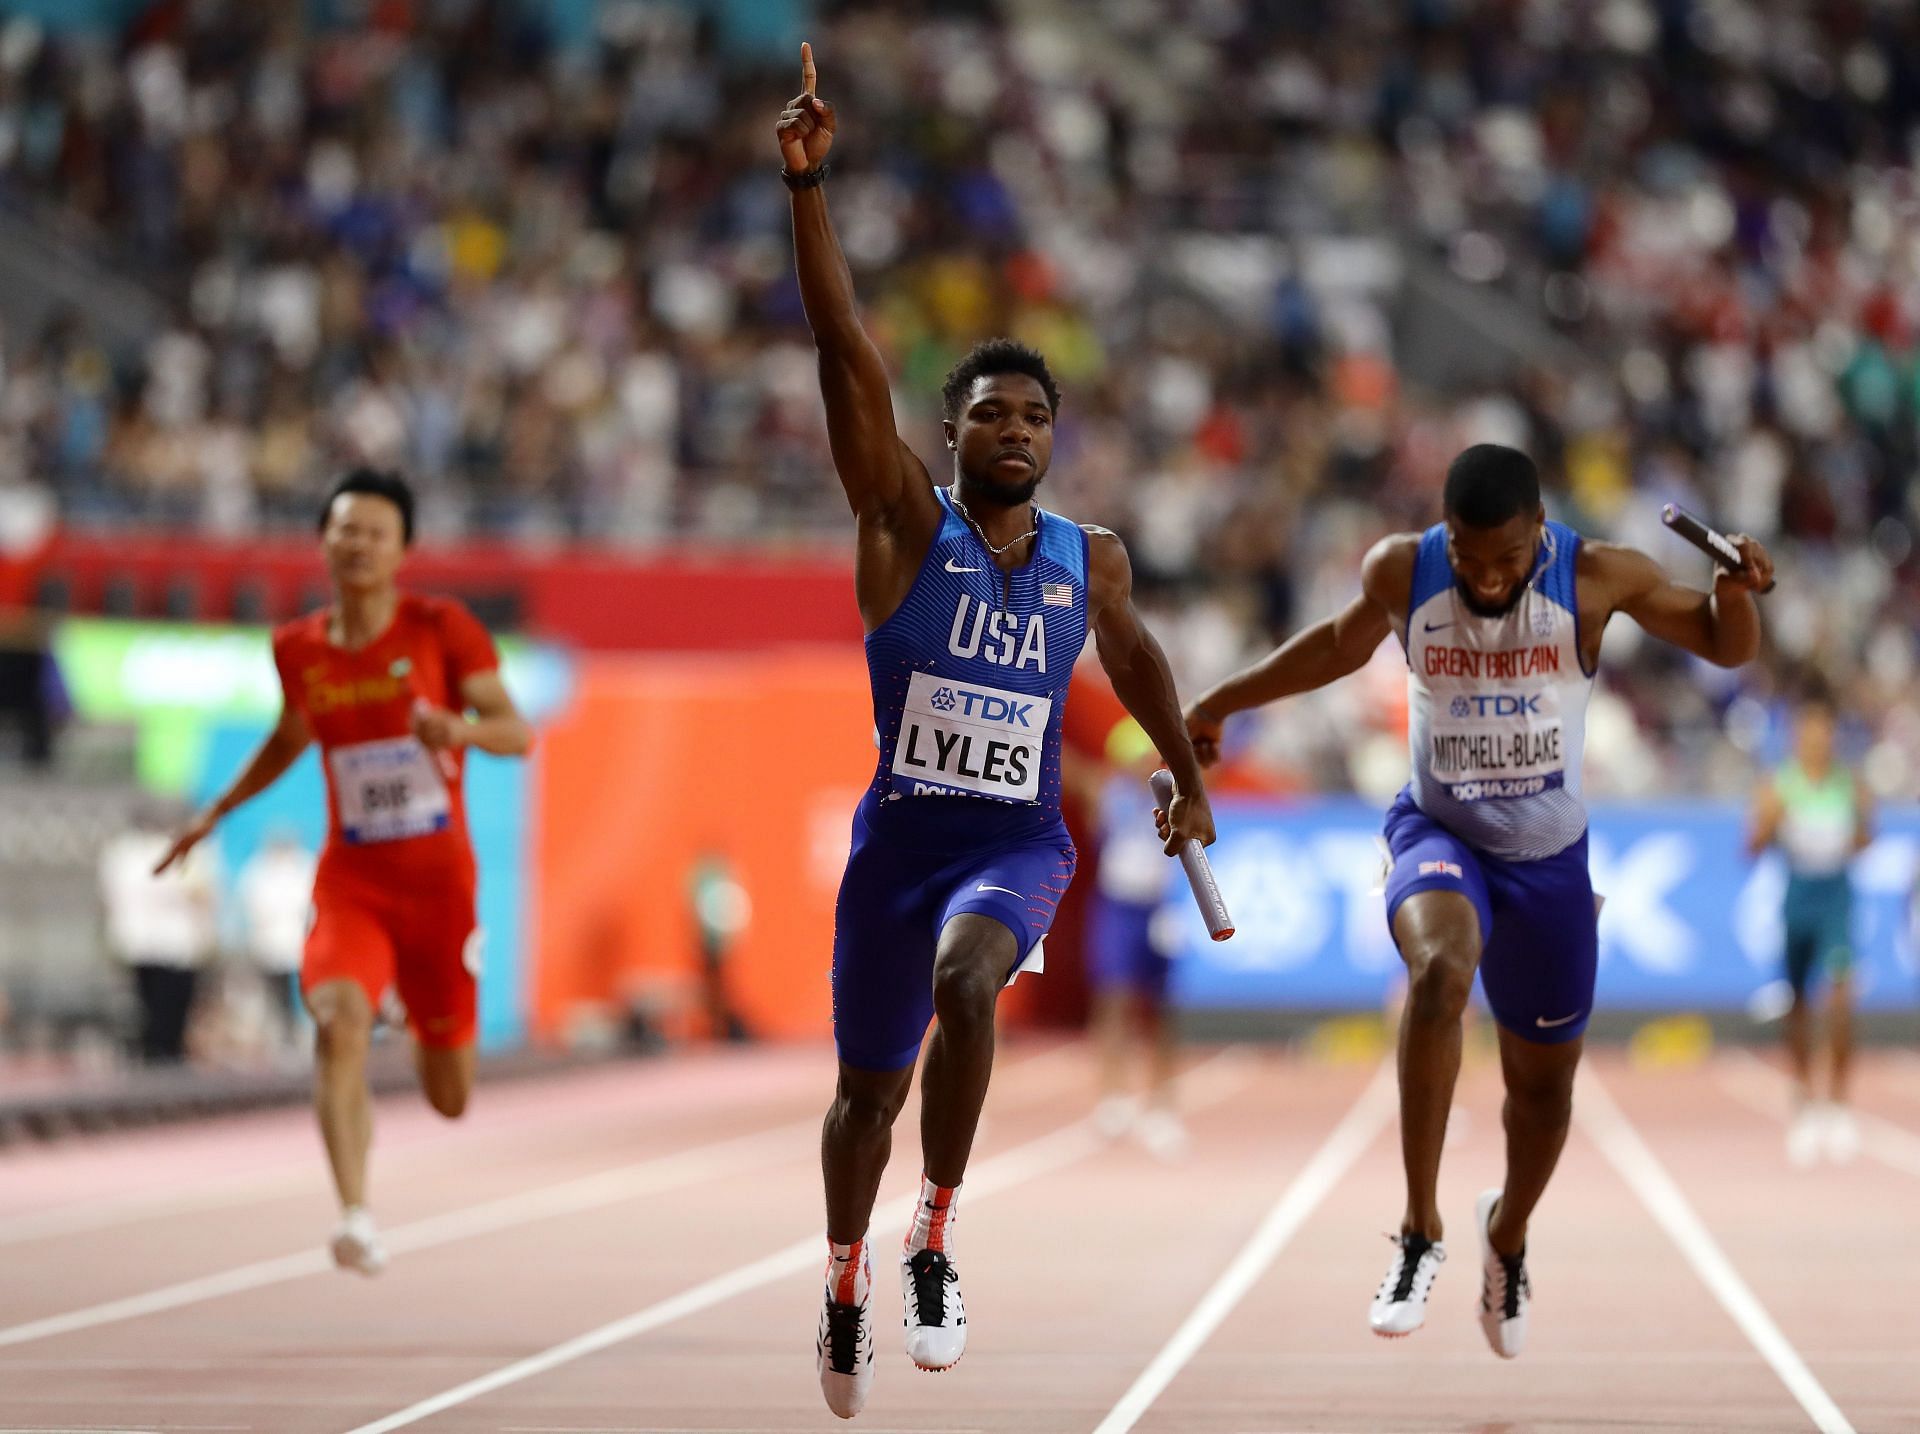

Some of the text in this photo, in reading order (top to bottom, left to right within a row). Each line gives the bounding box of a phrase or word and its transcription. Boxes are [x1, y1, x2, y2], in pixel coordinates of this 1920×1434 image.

[948, 593, 1047, 674] USA
[1424, 645, 1559, 679] GREAT BRITAIN
[957, 690, 1034, 728] TDK
[1470, 694, 1541, 717] TDK
[904, 724, 1030, 786] LYLES
[1433, 728, 1559, 772] MITCHELL-BLAKE
